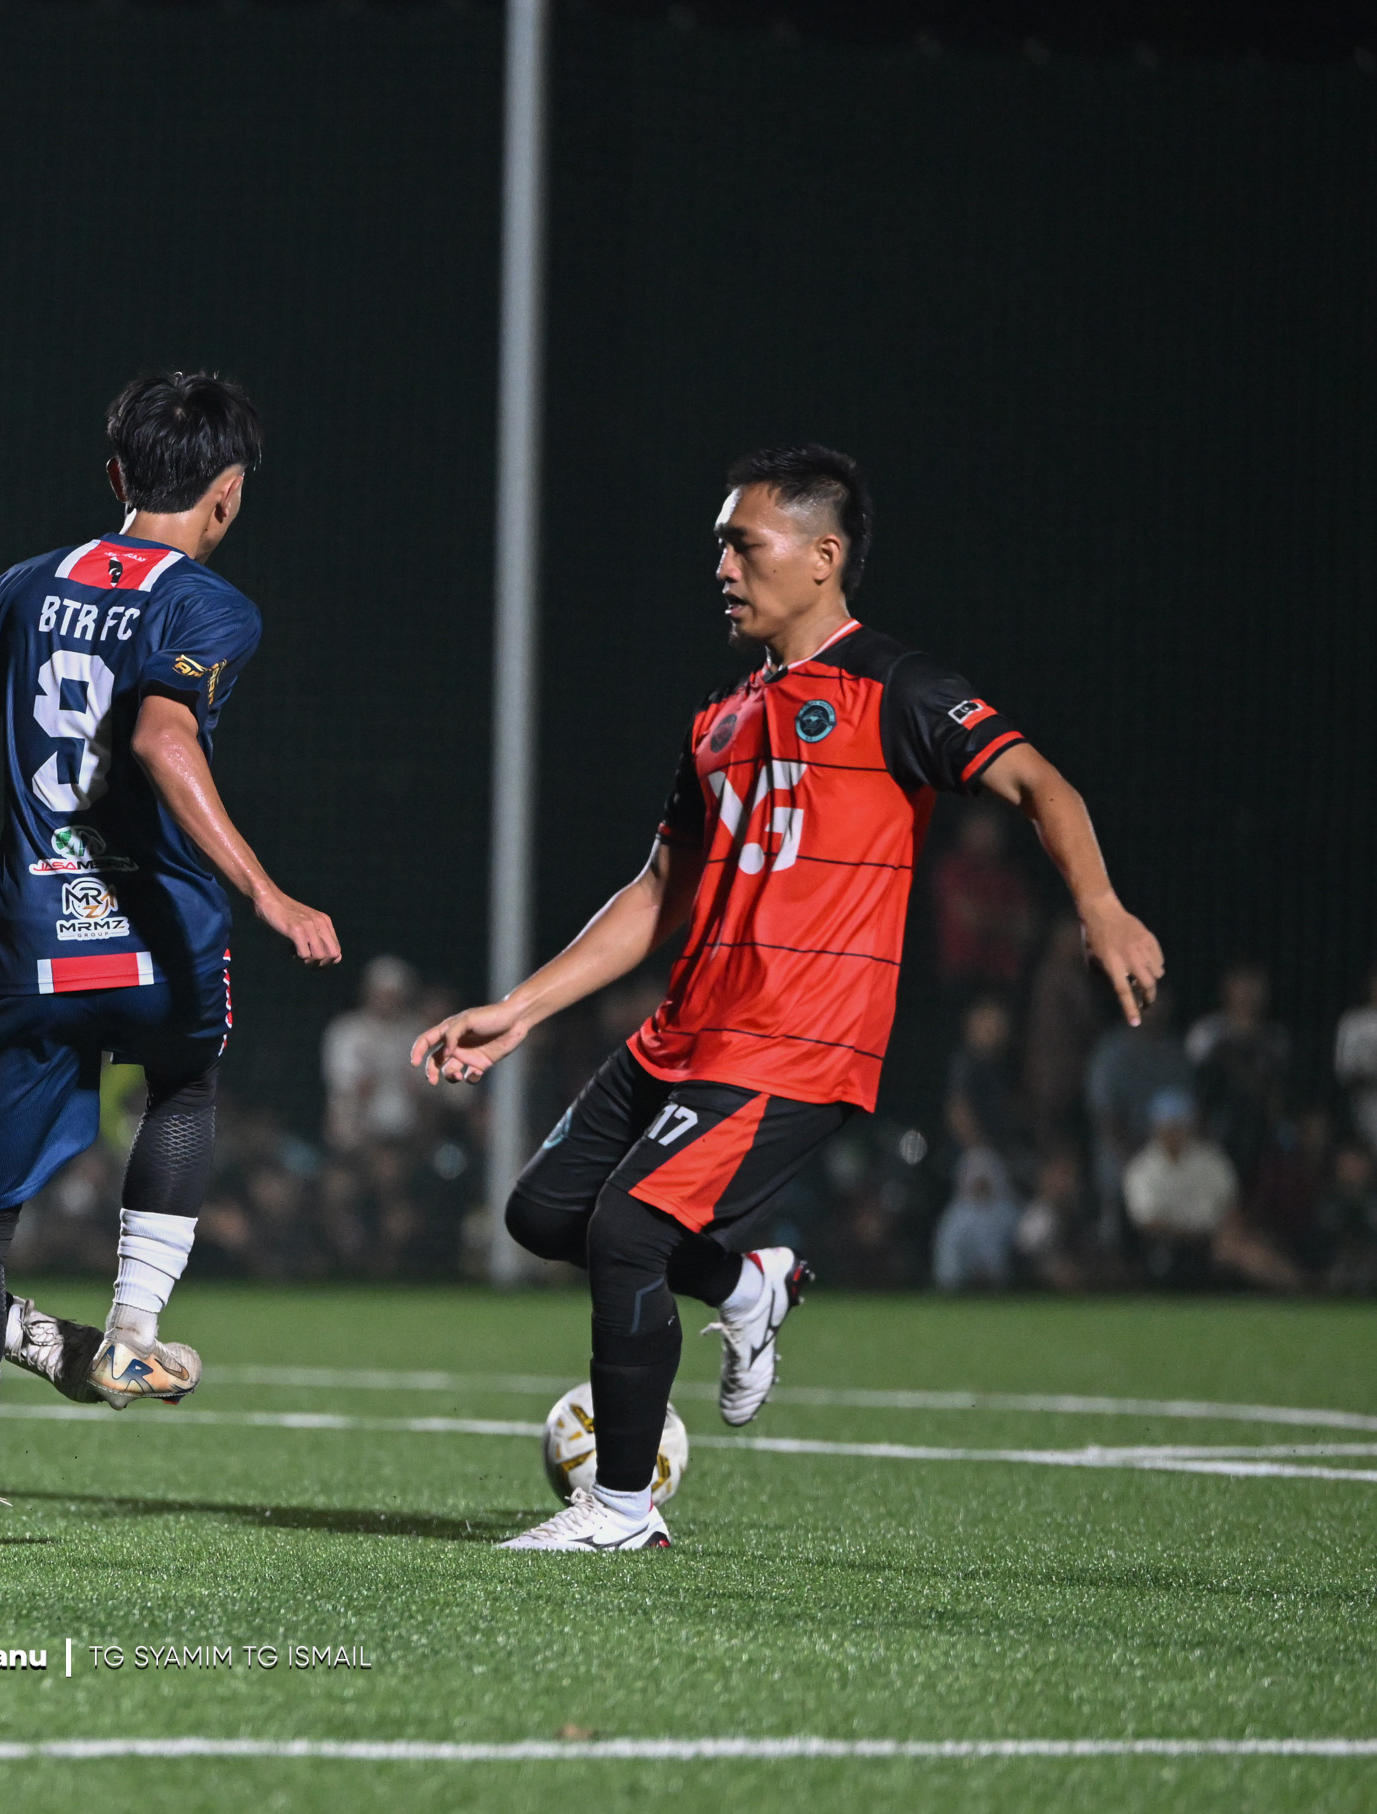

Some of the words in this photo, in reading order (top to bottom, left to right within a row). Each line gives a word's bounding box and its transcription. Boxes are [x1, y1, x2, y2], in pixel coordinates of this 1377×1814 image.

[38, 594, 98, 641] BTR
[99, 605, 141, 641] FC
[31, 649, 115, 812] 9
[59, 920, 126, 933] MRMZ
[647, 1104, 699, 1147] 17
